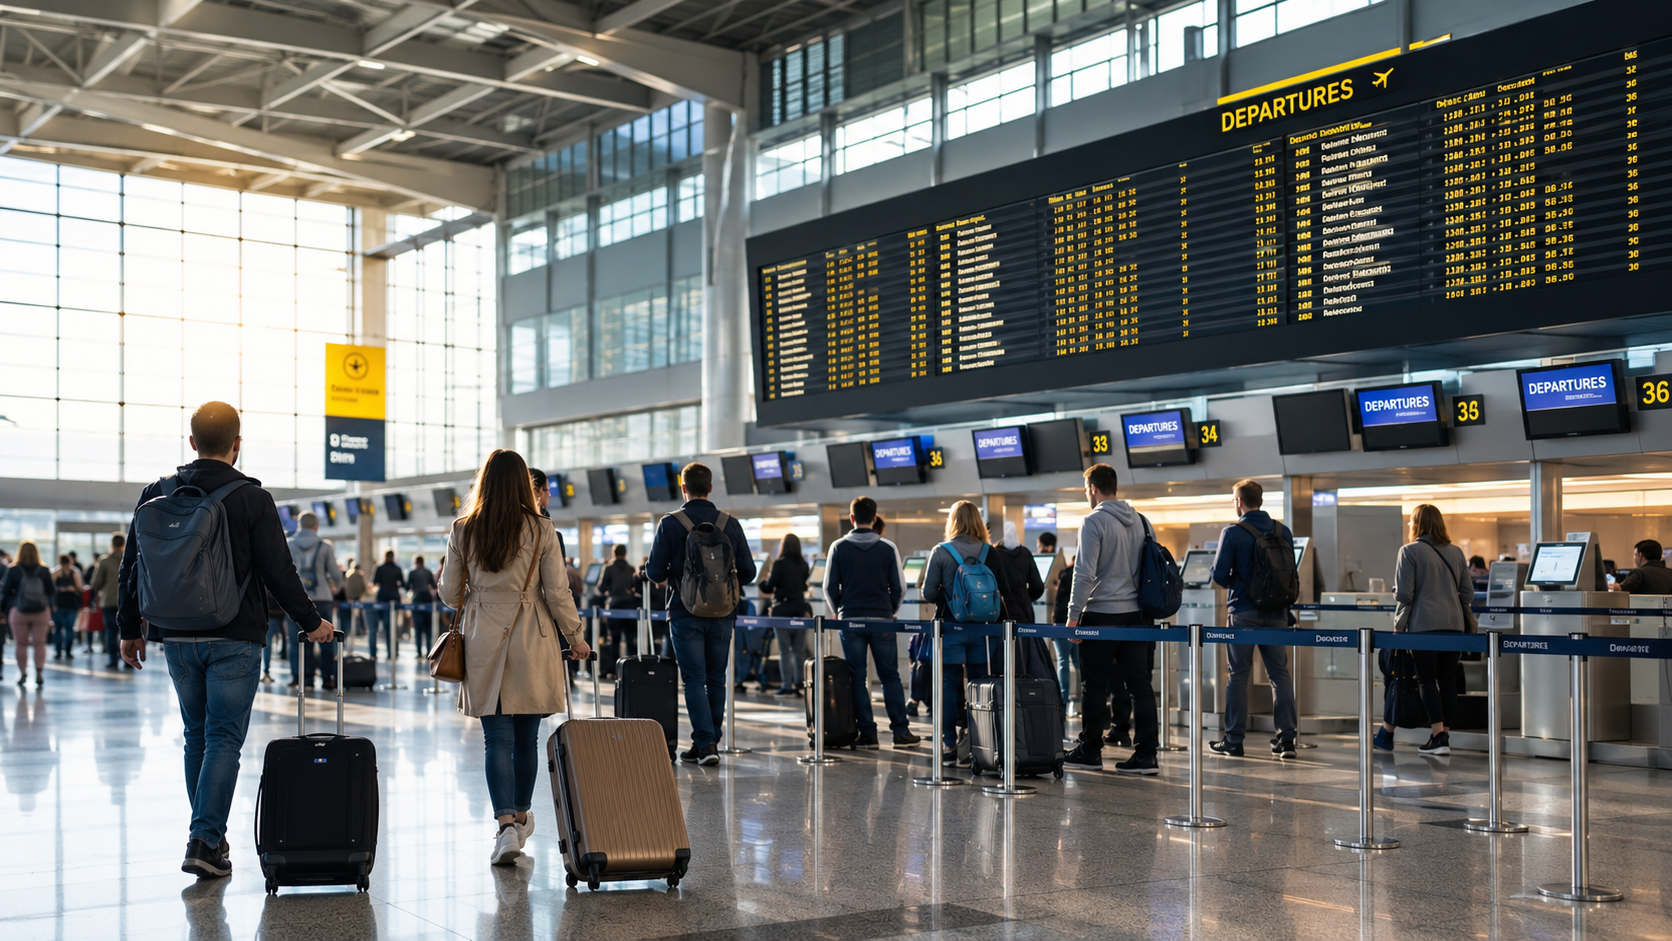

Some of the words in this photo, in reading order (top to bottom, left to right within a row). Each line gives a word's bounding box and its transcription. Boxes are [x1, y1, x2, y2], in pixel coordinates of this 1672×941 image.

[1221, 78, 1354, 133] DEPARTURES
[1528, 375, 1607, 395] DEPARTURES
[1642, 380, 1670, 405] 36
[1364, 395, 1430, 413] DEPARTURES
[1128, 420, 1179, 435] DEPARTURES
[1201, 424, 1219, 444] 34
[1093, 435, 1109, 453] 33
